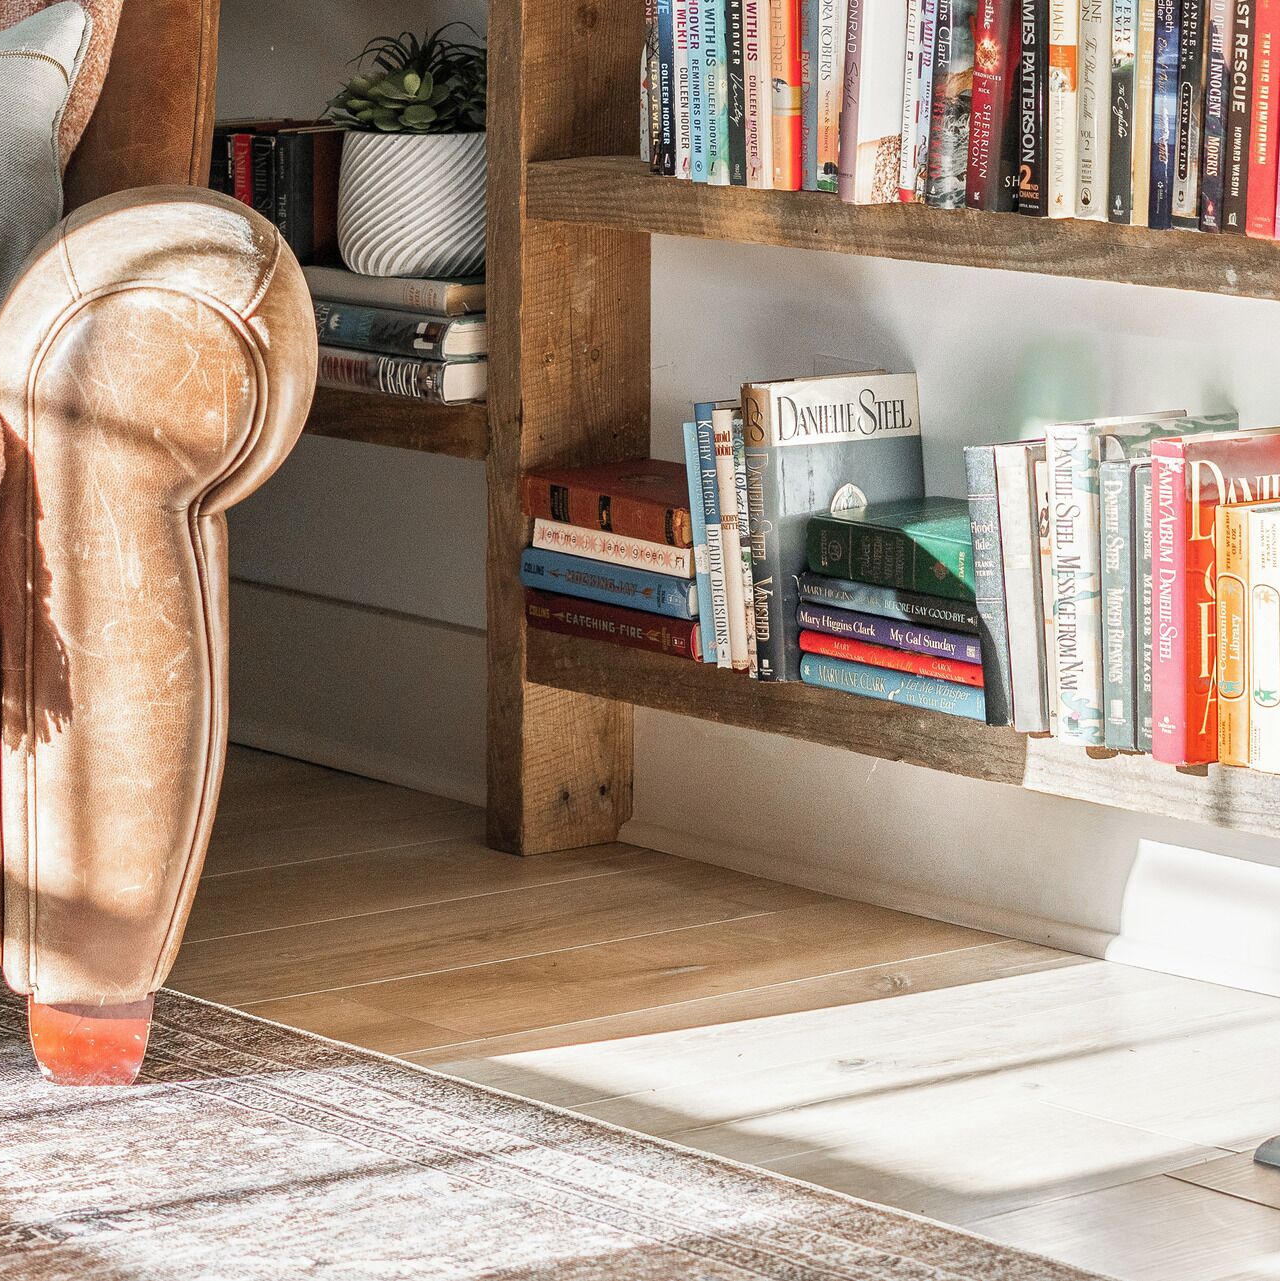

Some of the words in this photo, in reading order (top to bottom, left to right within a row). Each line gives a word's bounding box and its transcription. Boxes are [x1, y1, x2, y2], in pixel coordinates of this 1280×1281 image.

[704, 8, 716, 44] WITH
[732, 13, 741, 66] HOOVER
[746, 5, 758, 39] WITH
[705, 48, 717, 66] US
[746, 43, 758, 62] US
[936, 25, 952, 68] Clark
[661, 63, 670, 104] COLLEEN
[679, 67, 688, 109] COLLEEN
[691, 59, 701, 117] REMINDERS
[1231, 35, 1248, 114] RESCUE
[707, 74, 717, 116] COLLEEN
[729, 72, 743, 128] Verity
[748, 74, 757, 117] COLLEEN
[1020, 49, 1036, 164] PATTERSON
[662, 106, 670, 145] HOOVER
[680, 111, 690, 150] HOOVER
[693, 119, 701, 131] OF
[693, 135, 702, 153] HIM
[709, 118, 718, 157] HOOVER
[750, 119, 758, 158] HOOVER
[972, 111, 981, 168] KENYON
[979, 103, 992, 179] SHERRILYN
[1233, 126, 1242, 161] HOWARD
[1206, 135, 1219, 177] MORRIS
[1231, 163, 1240, 197] WASDIN
[377, 356, 421, 398] TRACE
[956, 551, 966, 579] DAVIS
[566, 612, 616, 634] CATCHING
[620, 622, 644, 640] FIRE
[800, 610, 820, 629] Mary
[821, 615, 852, 634] Higgins
[852, 620, 876, 637] Clark
[889, 628, 906, 644] My
[906, 631, 922, 646] Gal
[923, 633, 957, 653] Sunday
[1219, 601, 1228, 672] Companion
[1228, 614, 1242, 661] Library
[906, 679, 920, 690] Let
[920, 681, 935, 692] Me
[934, 683, 971, 702] Whisper
